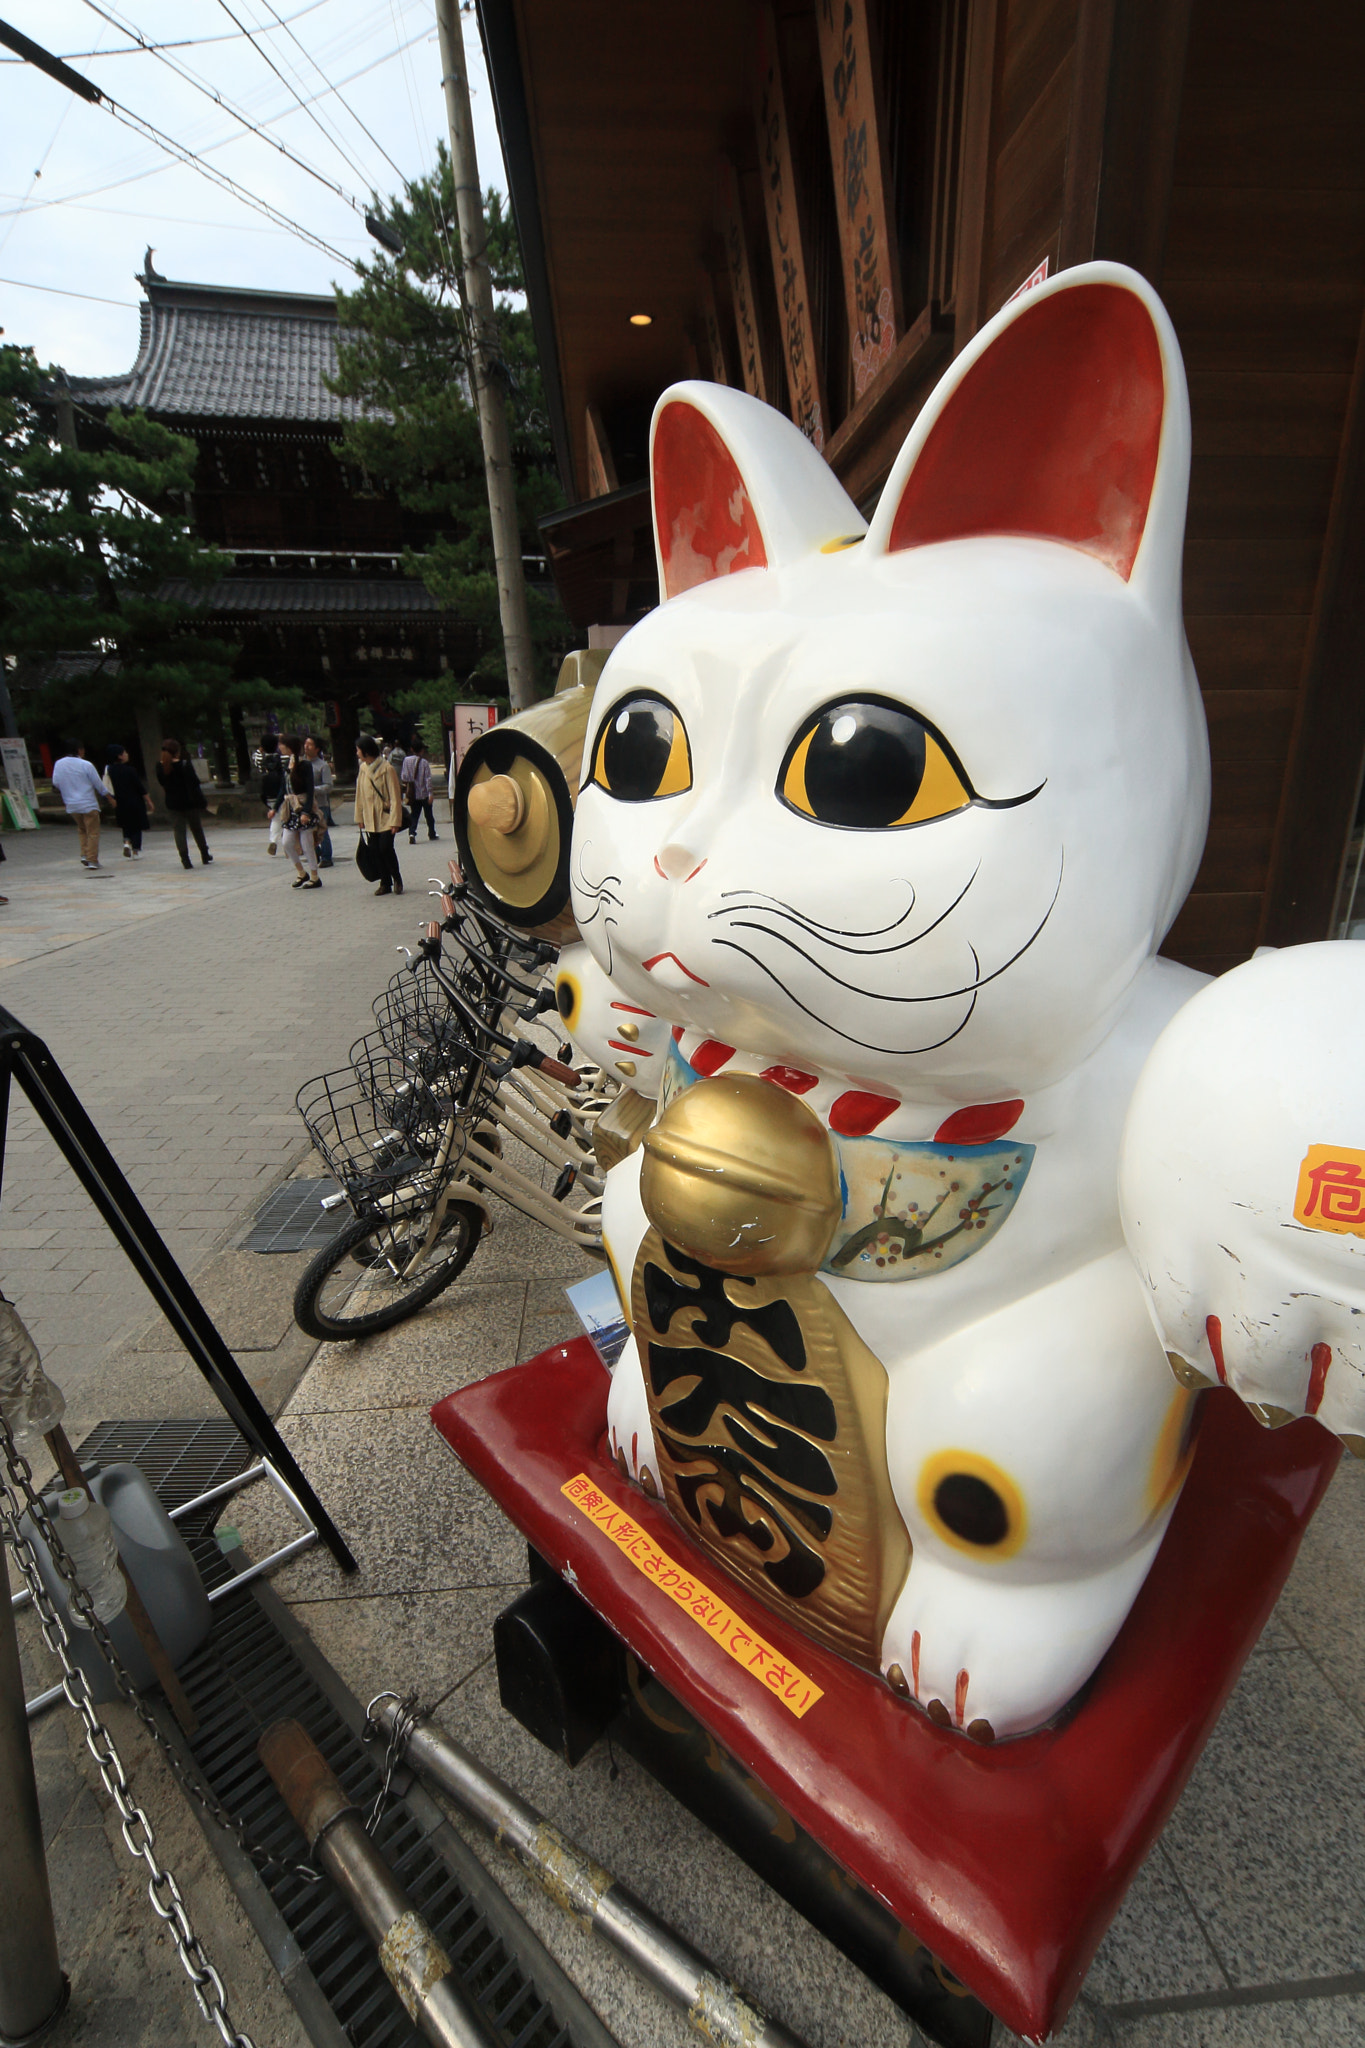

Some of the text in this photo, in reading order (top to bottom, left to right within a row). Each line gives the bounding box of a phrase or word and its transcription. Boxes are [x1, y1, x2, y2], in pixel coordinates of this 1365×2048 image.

[563, 1479, 811, 1708] 危険!人形にさわらないで下さい
